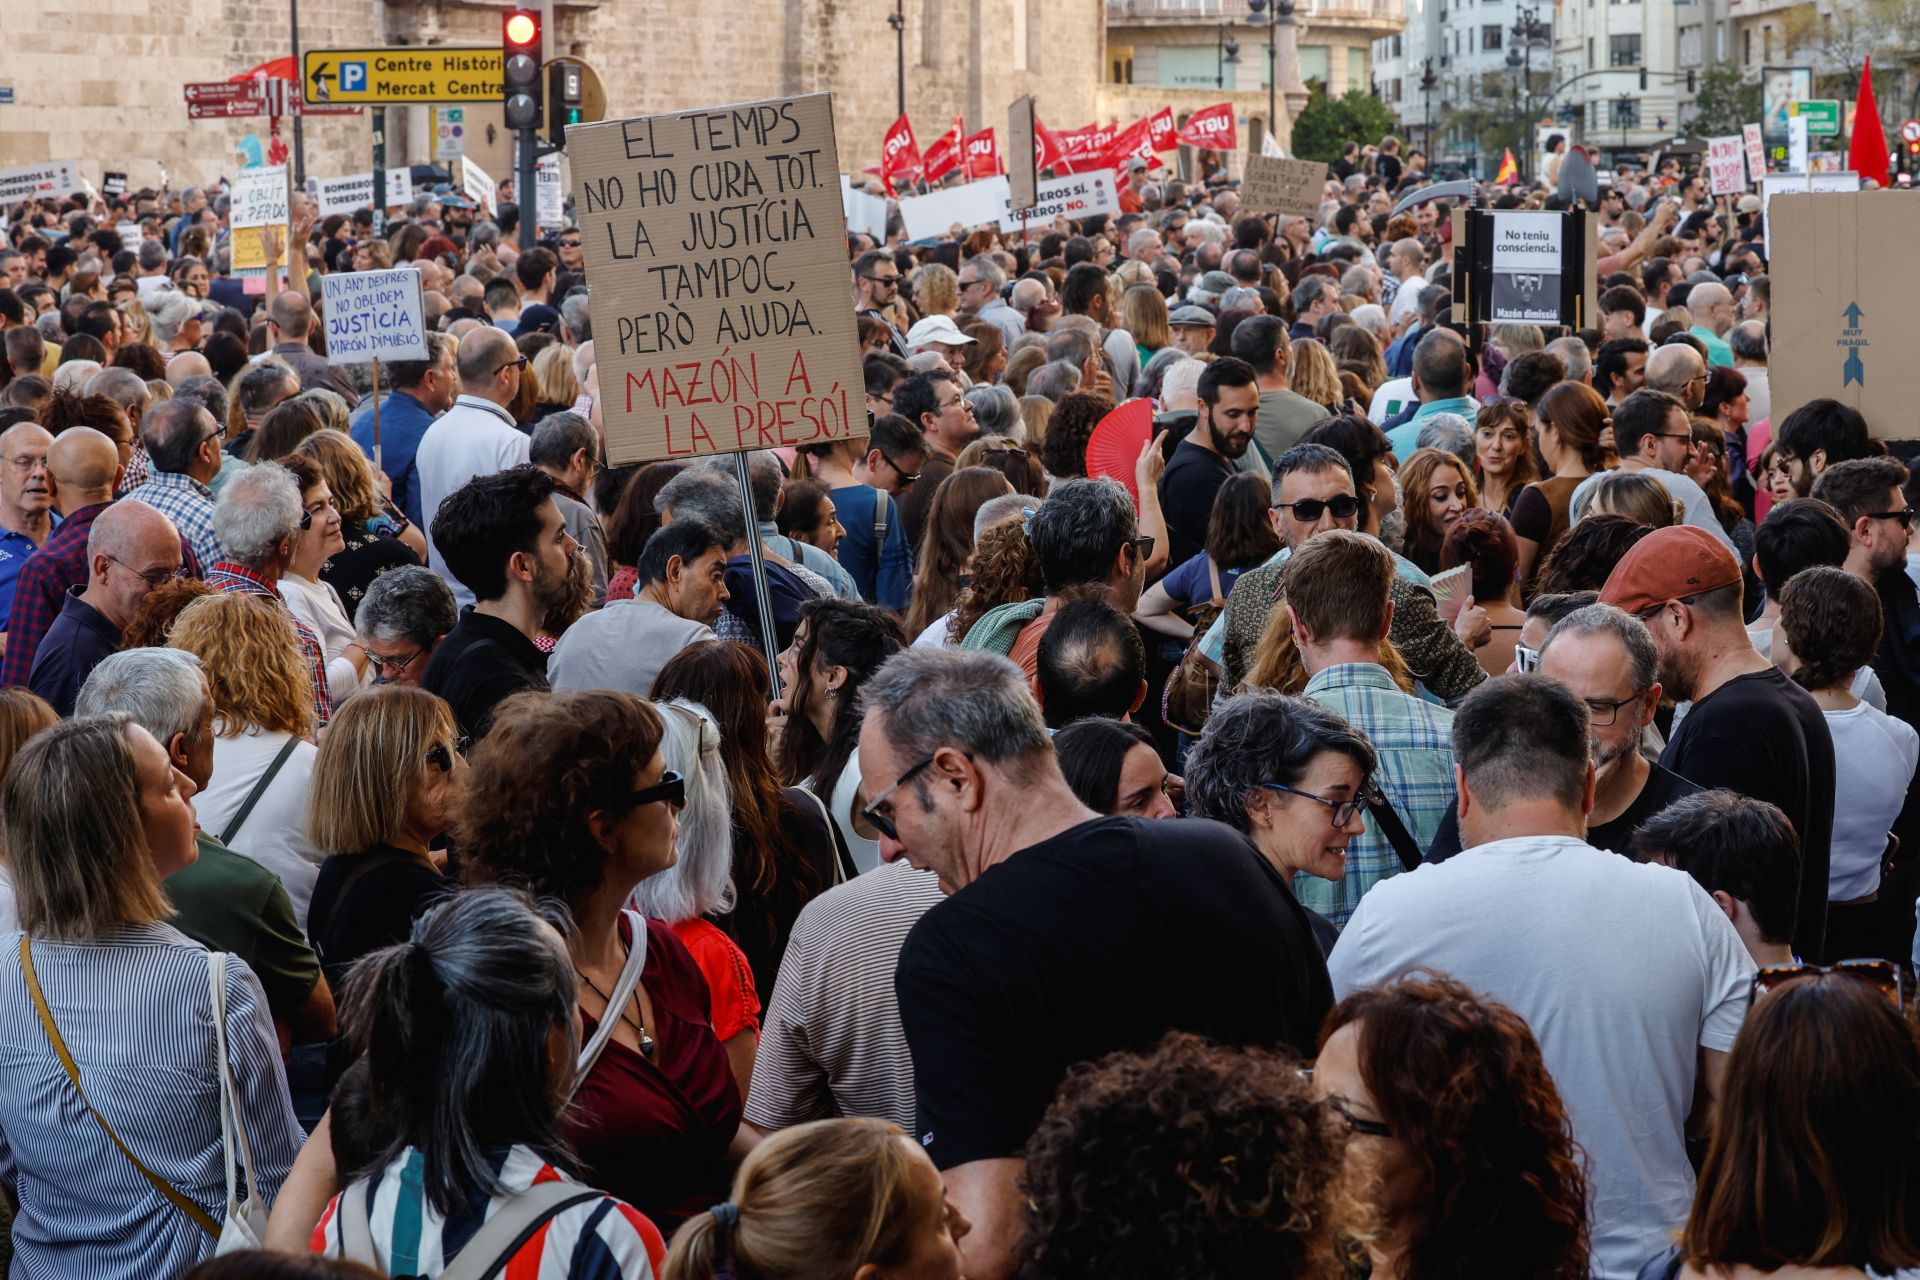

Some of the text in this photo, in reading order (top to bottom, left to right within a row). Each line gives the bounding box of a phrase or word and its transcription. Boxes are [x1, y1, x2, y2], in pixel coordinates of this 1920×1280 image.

[375, 56, 502, 72] Centre Històri
[377, 80, 504, 95] Mercat Centra
[569, 75, 577, 95] 9
[621, 102, 800, 160] EL TEMPS
[0, 172, 42, 185] OMBEROS
[583, 176, 624, 213] NO
[638, 168, 677, 207] HO
[690, 159, 763, 202] CURA
[765, 149, 824, 193] TOT.
[0, 185, 36, 197] OREROS
[326, 192, 370, 206] TOREROS
[1005, 182, 1089, 208] BEROS SÍ.
[1008, 203, 1064, 222] TOREROS
[1066, 200, 1088, 212] NO.
[606, 219, 656, 260] LA
[1505, 230, 1549, 240] No teniu
[1496, 243, 1559, 253] consciencia.
[647, 251, 796, 301] TAMPOC,
[325, 279, 341, 299] UN
[344, 276, 365, 295] ANY
[336, 299, 350, 314] NO
[1496, 308, 1557, 319] Mazón dimissió
[617, 299, 823, 355] PERÒ AJUDA.
[626, 346, 812, 413] MAZÓN A
[664, 381, 850, 456] LA PRESÓ!
